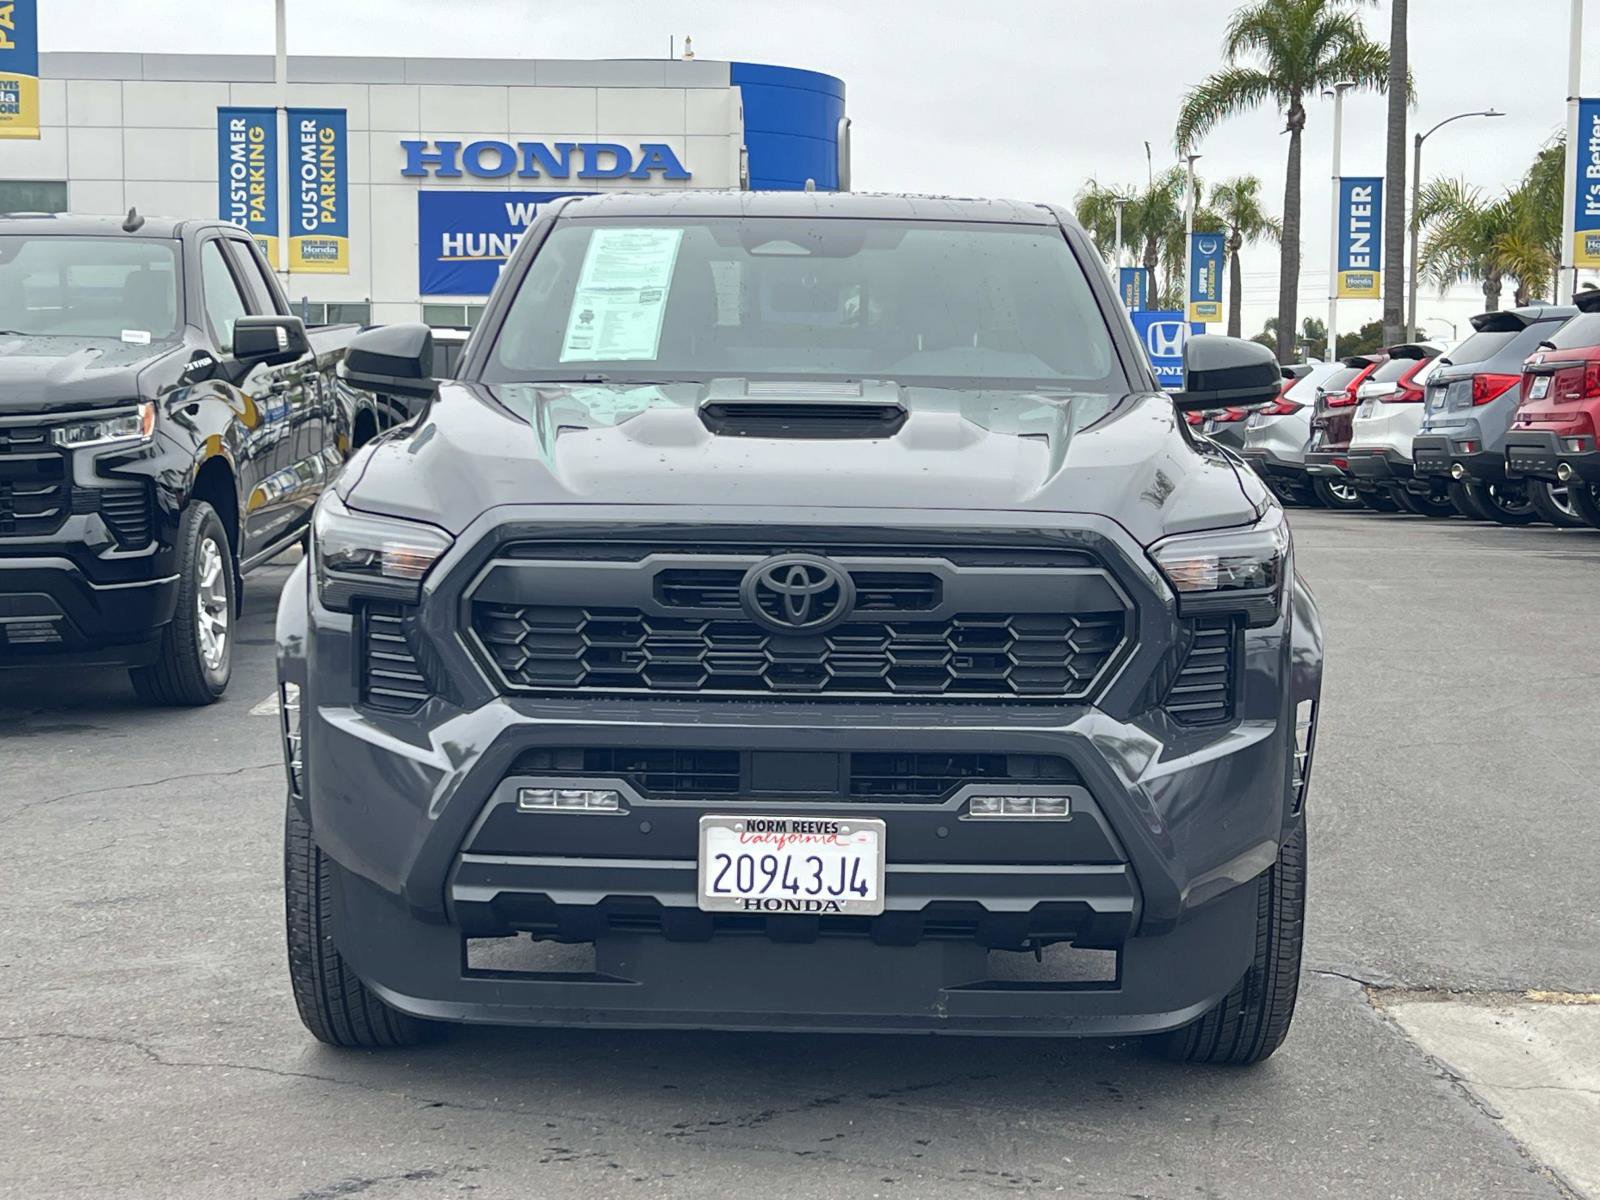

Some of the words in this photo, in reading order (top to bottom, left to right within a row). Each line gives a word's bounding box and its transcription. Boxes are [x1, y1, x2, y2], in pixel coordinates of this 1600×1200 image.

[0, 0, 15, 49] PA
[400, 140, 692, 180] HONDA
[1586, 114, 1600, 179] Better
[230, 118, 248, 229] CUSTOMER
[249, 126, 266, 222] PARKING
[301, 119, 319, 231] CUSTOMER
[319, 127, 336, 223] PARKING
[1584, 184, 1600, 216] It's
[303, 245, 337, 253] Honda
[1349, 185, 1372, 268] ENTER
[739, 833, 850, 851] California
[746, 819, 787, 833] NORM
[792, 820, 839, 834] REEVES
[713, 853, 869, 897] 20943J4
[743, 898, 841, 912] HONDA
